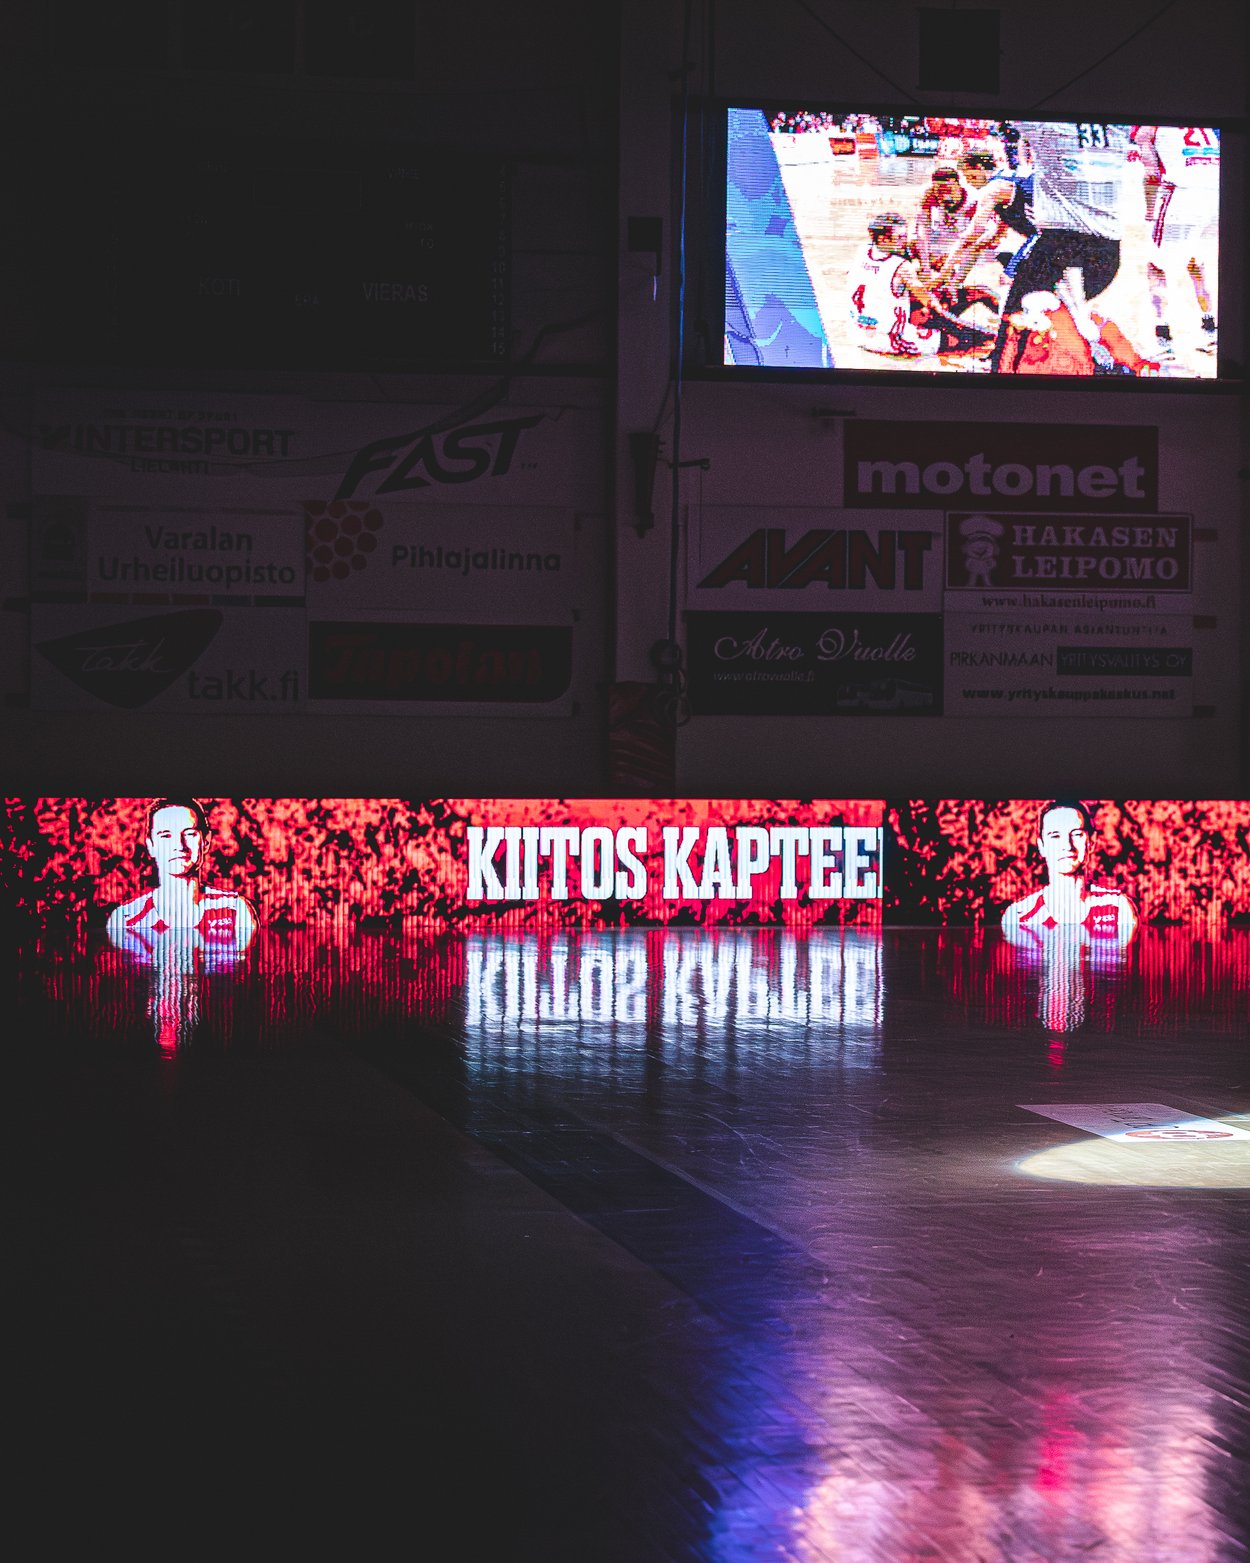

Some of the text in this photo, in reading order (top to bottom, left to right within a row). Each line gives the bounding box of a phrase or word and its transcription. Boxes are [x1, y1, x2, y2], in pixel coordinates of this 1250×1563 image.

[362, 281, 431, 303] VIERAS
[74, 423, 295, 457] INTERSPORT
[335, 414, 547, 501] FAST
[856, 452, 1146, 499] motonet
[145, 525, 253, 552] Varalan
[1012, 523, 1179, 550] HAKASEN
[99, 555, 296, 589] Urheiluopisto
[392, 545, 561, 577] Pihlajalinna
[696, 528, 933, 590] AVANT
[1012, 553, 1180, 581] LEIPOMO
[714, 627, 917, 662] Atro Vuolle
[949, 651, 1054, 668] PIRKANMAAN
[189, 668, 299, 701] takk.fi
[466, 826, 884, 900] KIITOS KAPTEE
